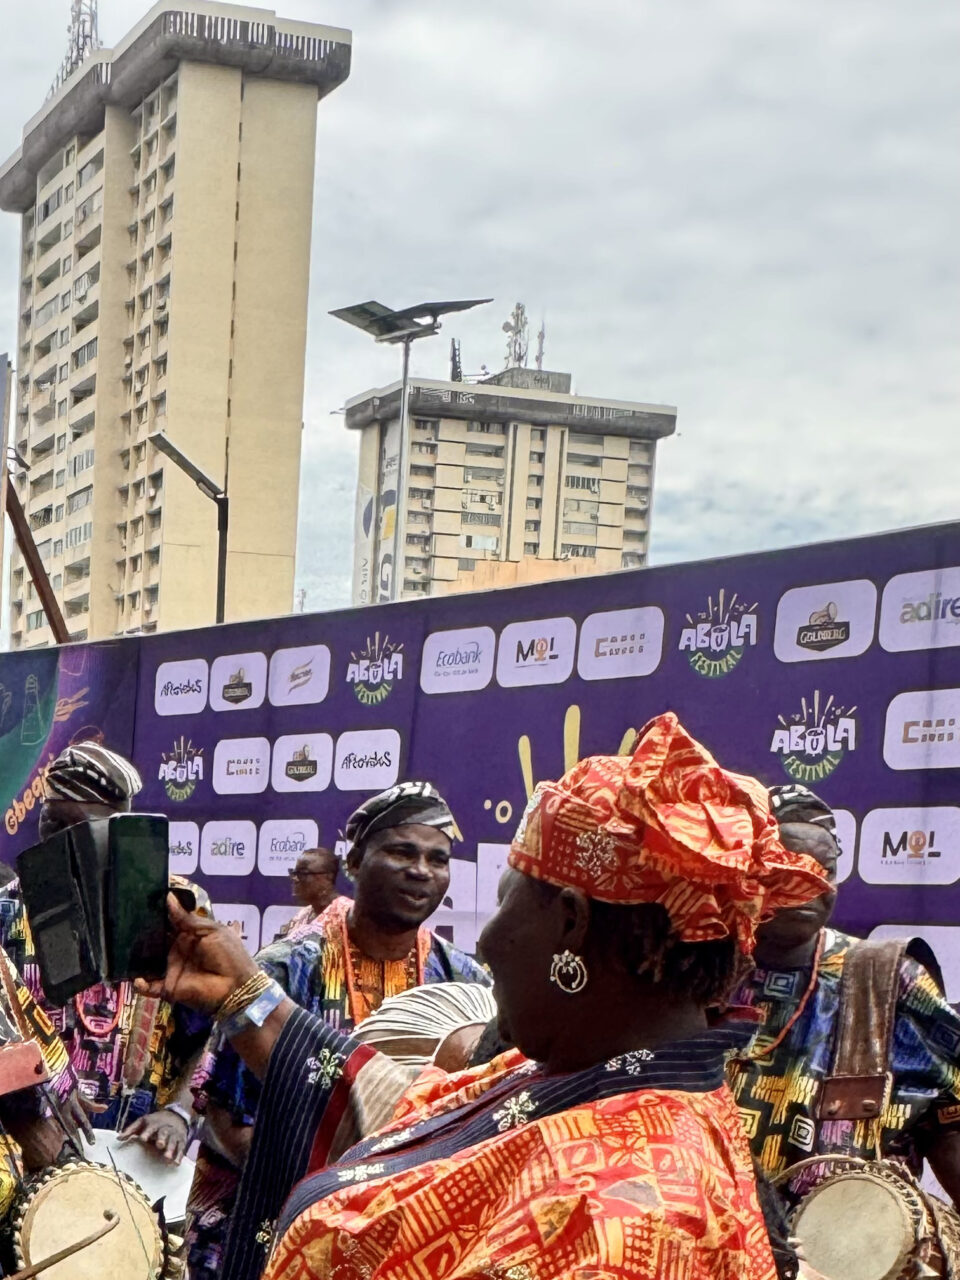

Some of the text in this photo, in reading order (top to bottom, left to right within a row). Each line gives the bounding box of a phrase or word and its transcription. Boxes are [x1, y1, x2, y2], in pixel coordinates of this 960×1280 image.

[679, 613, 758, 652] ABULA
[435, 641, 483, 668] Ecobank
[689, 650, 742, 677] FESTIVAL
[770, 717, 856, 757] ABULA
[783, 755, 842, 783] FESTIVAL
